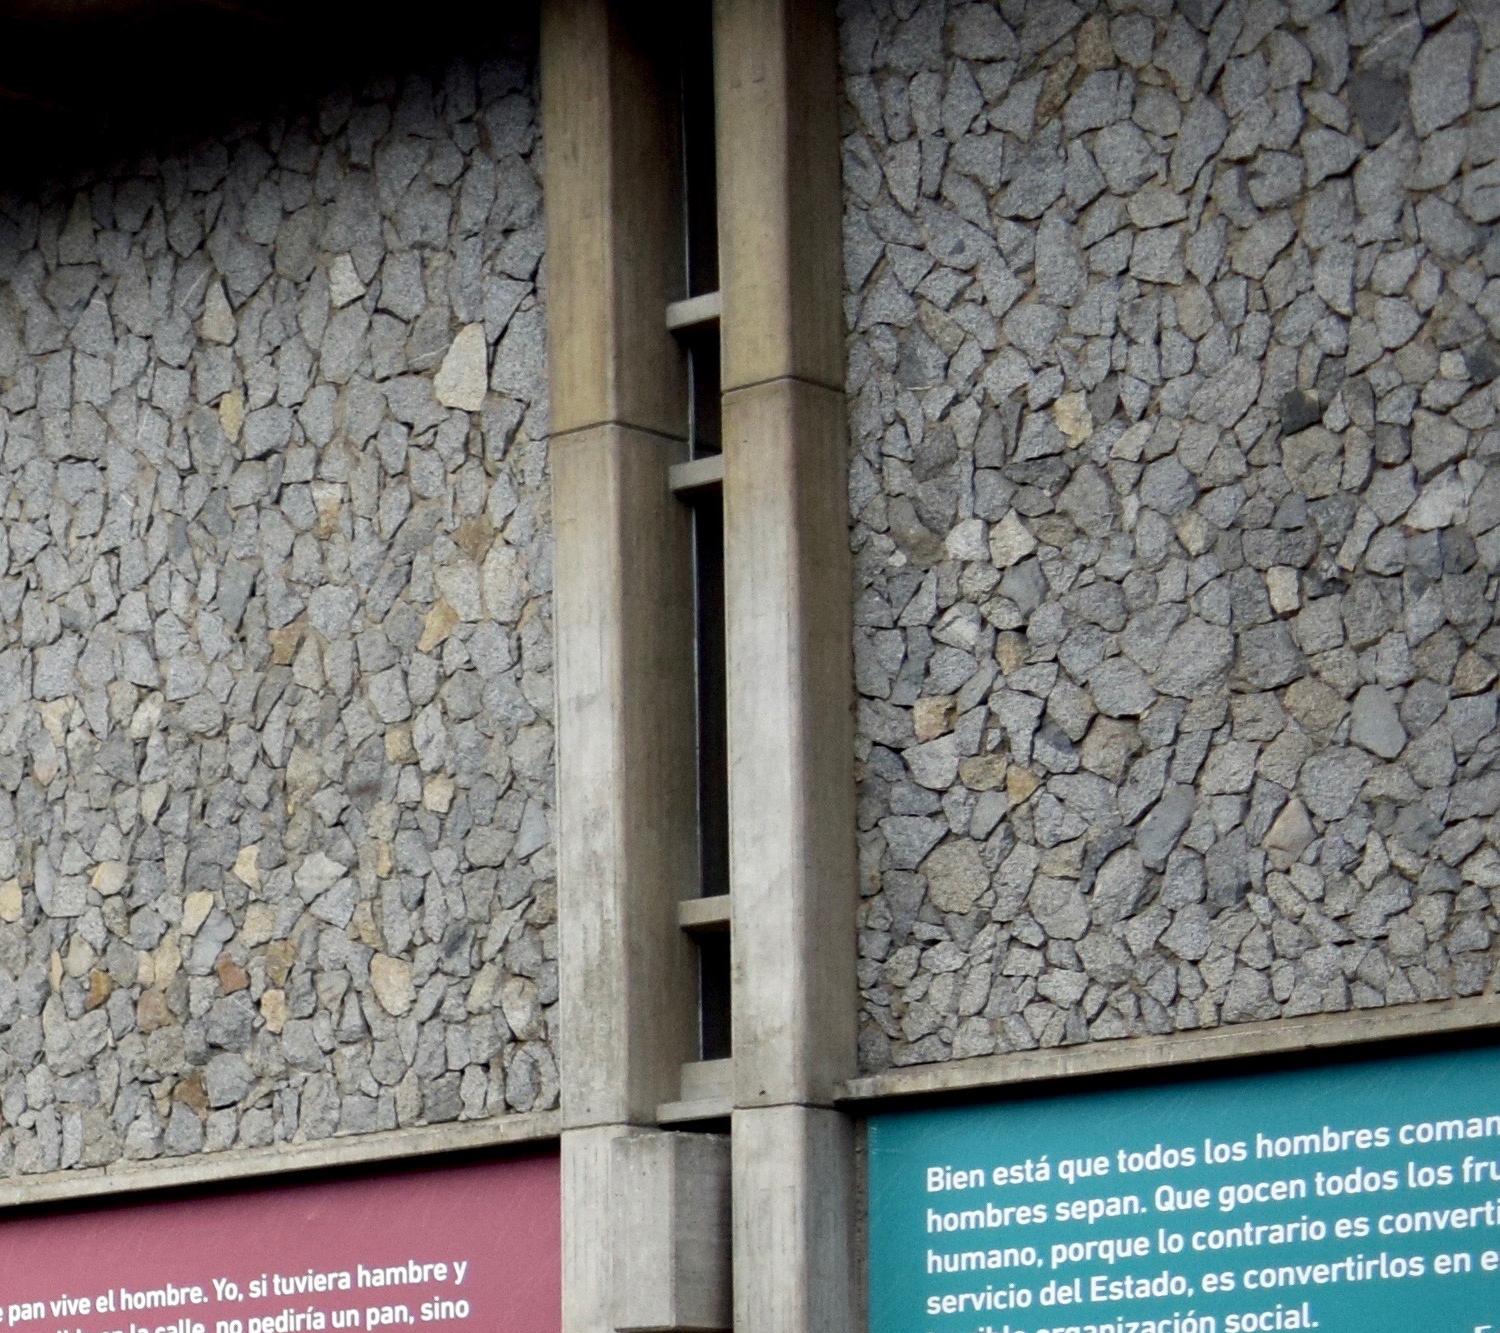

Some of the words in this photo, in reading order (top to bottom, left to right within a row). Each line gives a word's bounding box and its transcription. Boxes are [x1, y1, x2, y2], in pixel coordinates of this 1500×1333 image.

[927, 1166, 984, 1192] Bien
[992, 1156, 1050, 1185] está
[1058, 1156, 1109, 1184] que
[1117, 1144, 1196, 1173] todos
[1205, 1139, 1247, 1164] los
[1256, 1126, 1390, 1158] hombres
[927, 1203, 1047, 1232] hombres
[1056, 1196, 1146, 1224] sepan.
[1155, 1186, 1210, 1211] Que
[1219, 1179, 1306, 1212] gocen
[1315, 1167, 1398, 1196] todos
[1408, 1162, 1453, 1188] los
[927, 1247, 1043, 1273] humano,
[1052, 1237, 1149, 1269] porque
[1158, 1229, 1184, 1253] lo
[1192, 1216, 1326, 1250] contrario
[1335, 1217, 1369, 1238] es
[9, 1302, 45, 1326] pan
[50, 1294, 91, 1317] vive
[96, 1290, 115, 1313] el
[121, 1284, 208, 1310] hombre.
[213, 1278, 243, 1301] Yo,
[249, 1274, 267, 1298] si
[273, 1269, 350, 1295] tuviera
[358, 1260, 447, 1287] hambre
[454, 1261, 467, 1285] y
[332, 1309, 359, 1328] un
[366, 1305, 414, 1331] pan,
[421, 1296, 469, 1321] sino
[927, 1284, 1032, 1314] servicio
[1040, 1278, 1082, 1306] del
[1091, 1271, 1193, 1301] Estado,
[1202, 1272, 1235, 1292] es
[1244, 1253, 1425, 1289] convertirlos
[1434, 1253, 1471, 1274] en
[1225, 1302, 1318, 1333] social.
